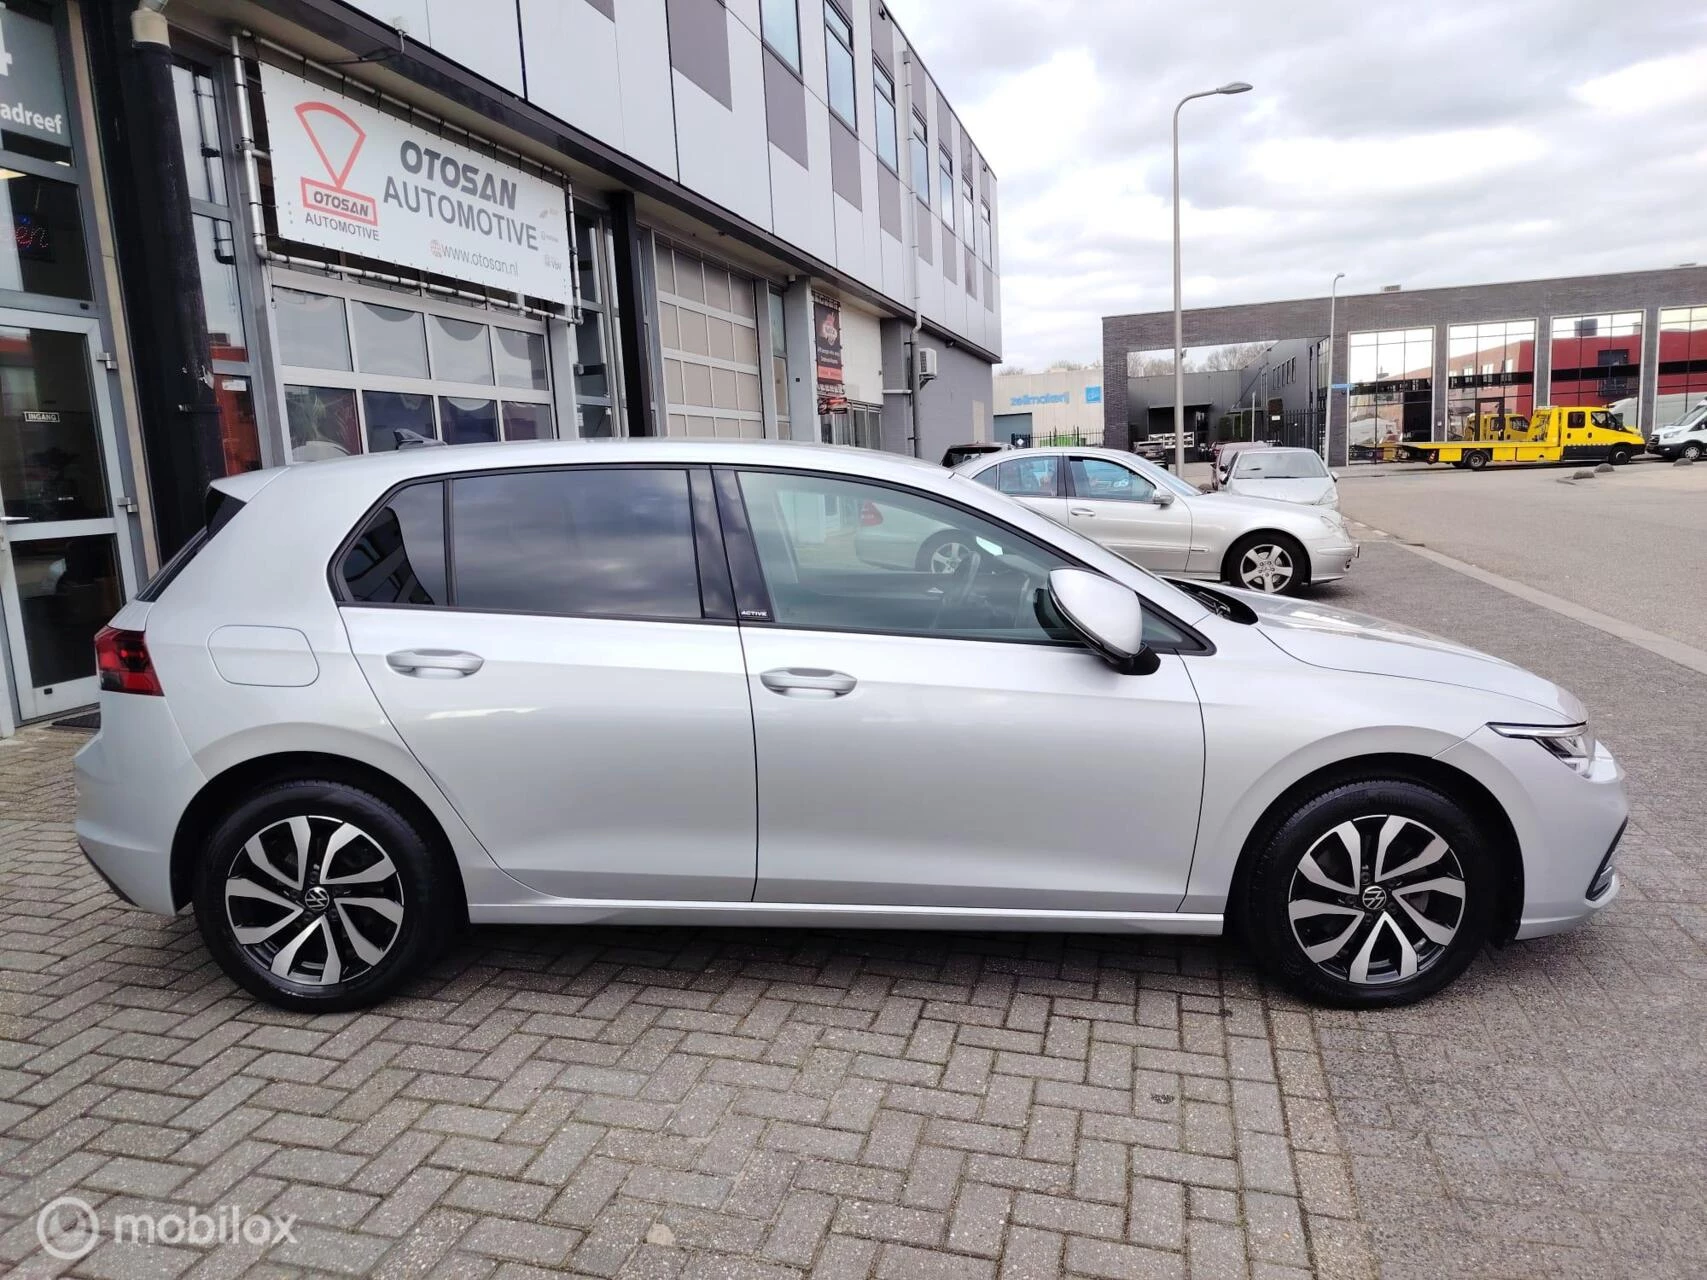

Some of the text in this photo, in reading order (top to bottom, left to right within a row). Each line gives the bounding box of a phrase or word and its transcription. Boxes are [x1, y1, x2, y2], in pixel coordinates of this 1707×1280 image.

[400, 139, 518, 211] OTOSAN
[313, 190, 369, 218] OTOSAN
[383, 175, 539, 252] AUTOMOTIVE
[304, 211, 380, 242] AUTOMOTIVE
[441, 243, 520, 278] www.otosan.nl
[28, 413, 57, 421] INGANG
